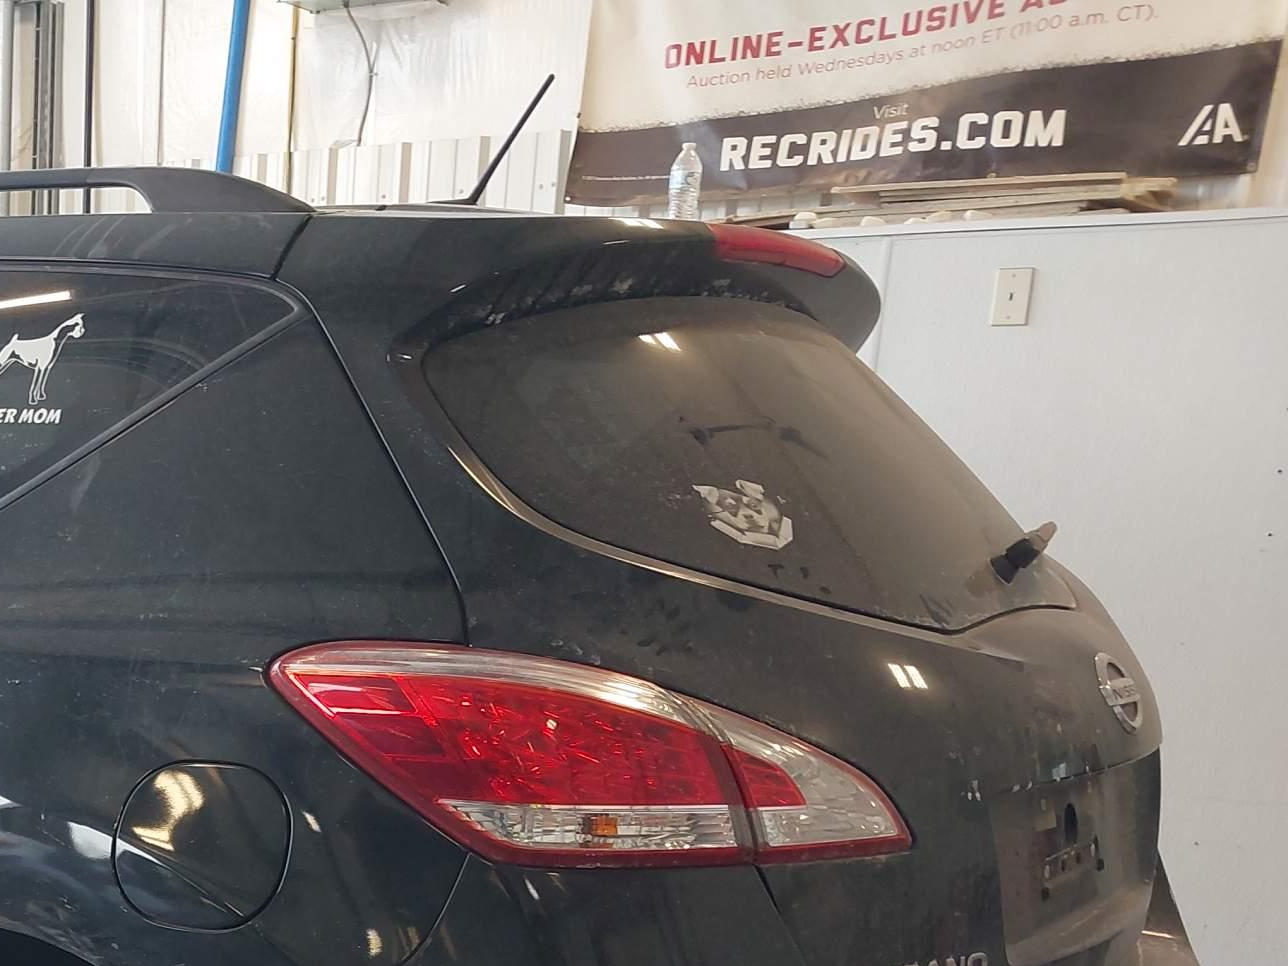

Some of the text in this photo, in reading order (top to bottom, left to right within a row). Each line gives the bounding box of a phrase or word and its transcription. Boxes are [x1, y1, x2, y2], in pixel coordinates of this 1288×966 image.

[665, 0, 1005, 69] ONLINE-EXCLUSIVE
[686, 72, 750, 89] Auction
[755, 65, 792, 81] held
[798, 50, 904, 76] Wednesdays
[909, 43, 926, 58] at
[931, 36, 976, 54] noon
[981, 28, 1004, 45] ET
[1068, 11, 1108, 27] a.m.
[719, 109, 1067, 172] RECRIDES.COM
[873, 103, 909, 121] Visit
[18, 408, 62, 424] MOM
